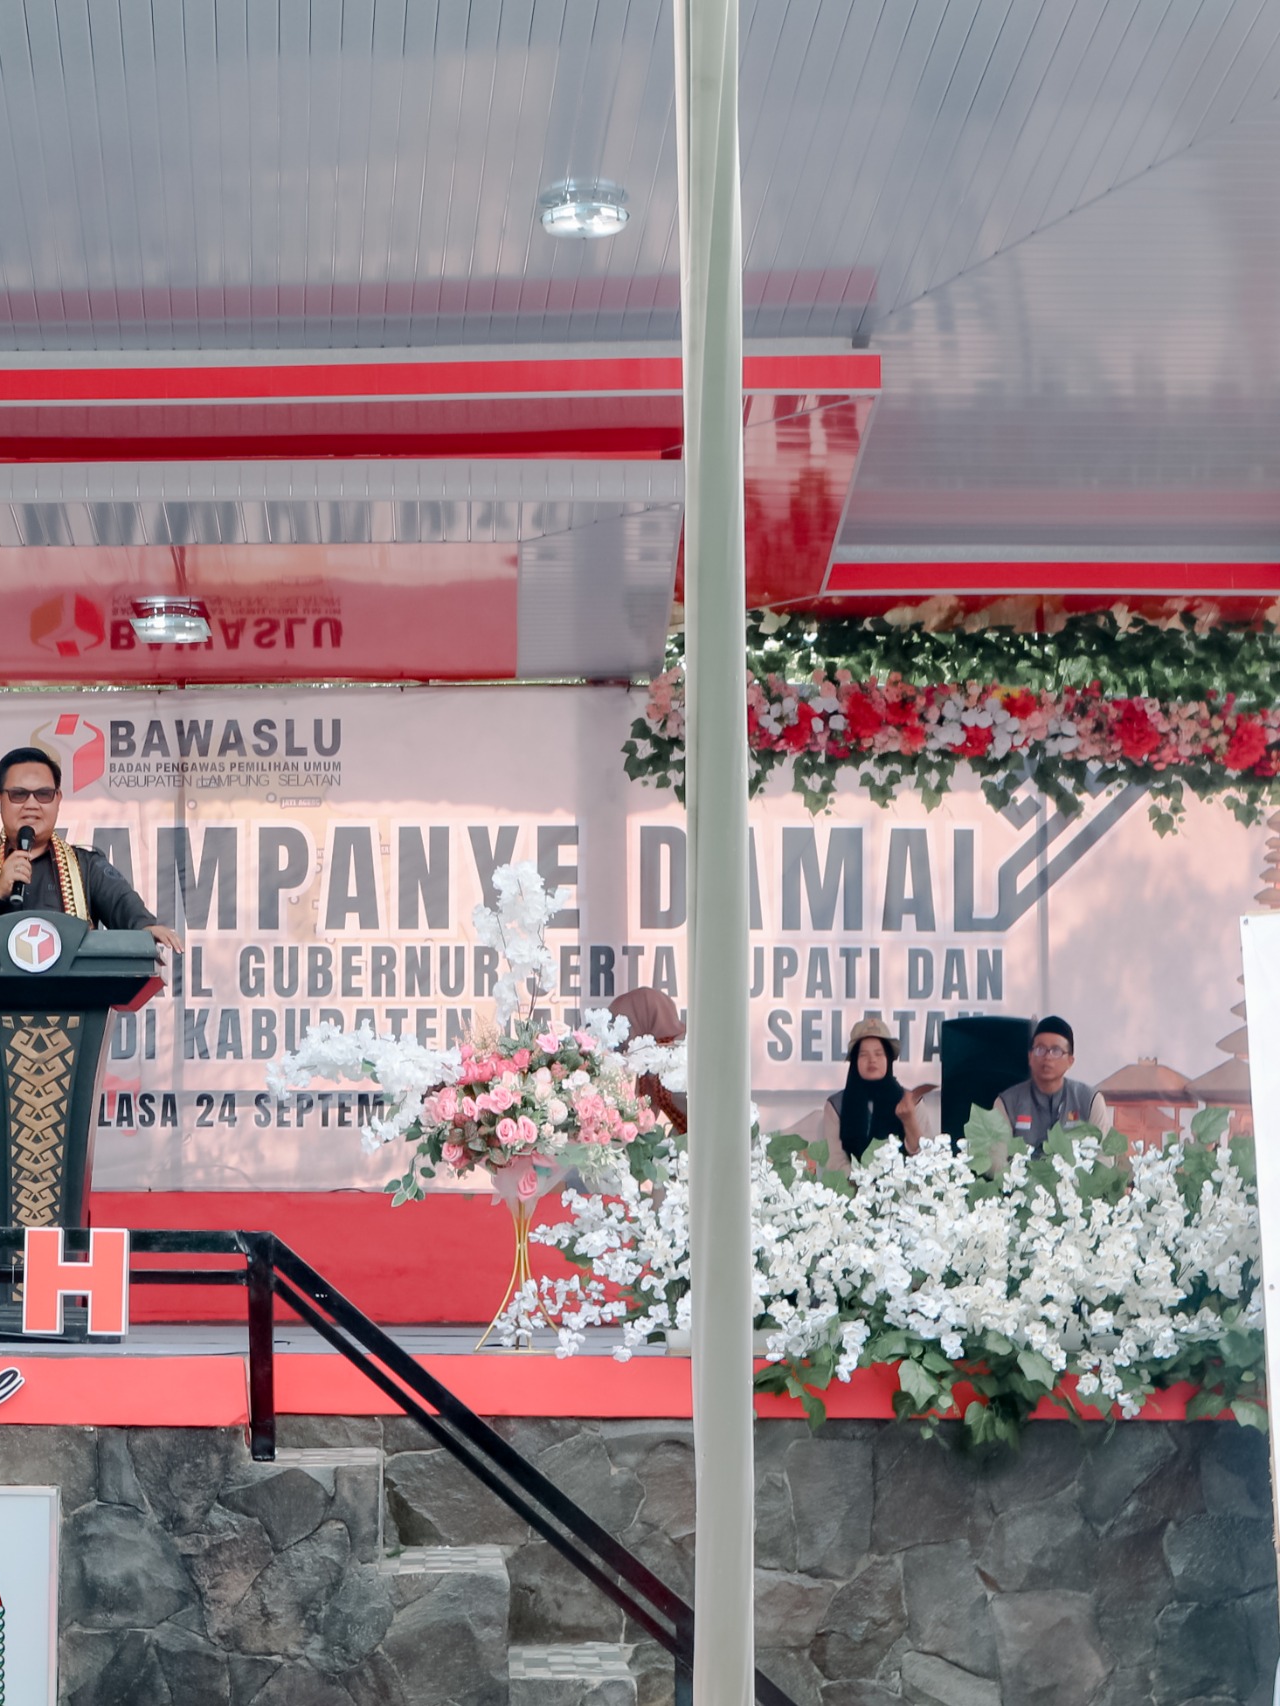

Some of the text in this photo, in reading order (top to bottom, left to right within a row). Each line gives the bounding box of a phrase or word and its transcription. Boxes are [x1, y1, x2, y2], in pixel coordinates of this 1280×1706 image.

[109, 718, 342, 758] BAWASLU
[108, 774, 192, 788] KABUPATEN
[200, 774, 270, 788] LAMPUNG
[278, 773, 341, 787] SELATAN
[109, 761, 342, 773] BADAN PENGAWAS PEMILIHAN UMUM
[54, 826, 580, 930] AMPANYE
[639, 826, 977, 931] DMAI
[240, 945, 500, 998] GUBERNUR
[749, 946, 880, 999] UPATI
[908, 947, 1003, 1000] DAN
[110, 1008, 156, 1060] DI
[766, 1009, 984, 1062] SELTA
[98, 1092, 178, 1127] LASA
[196, 1093, 239, 1127] 24
[257, 1091, 386, 1128] SEPTEM
